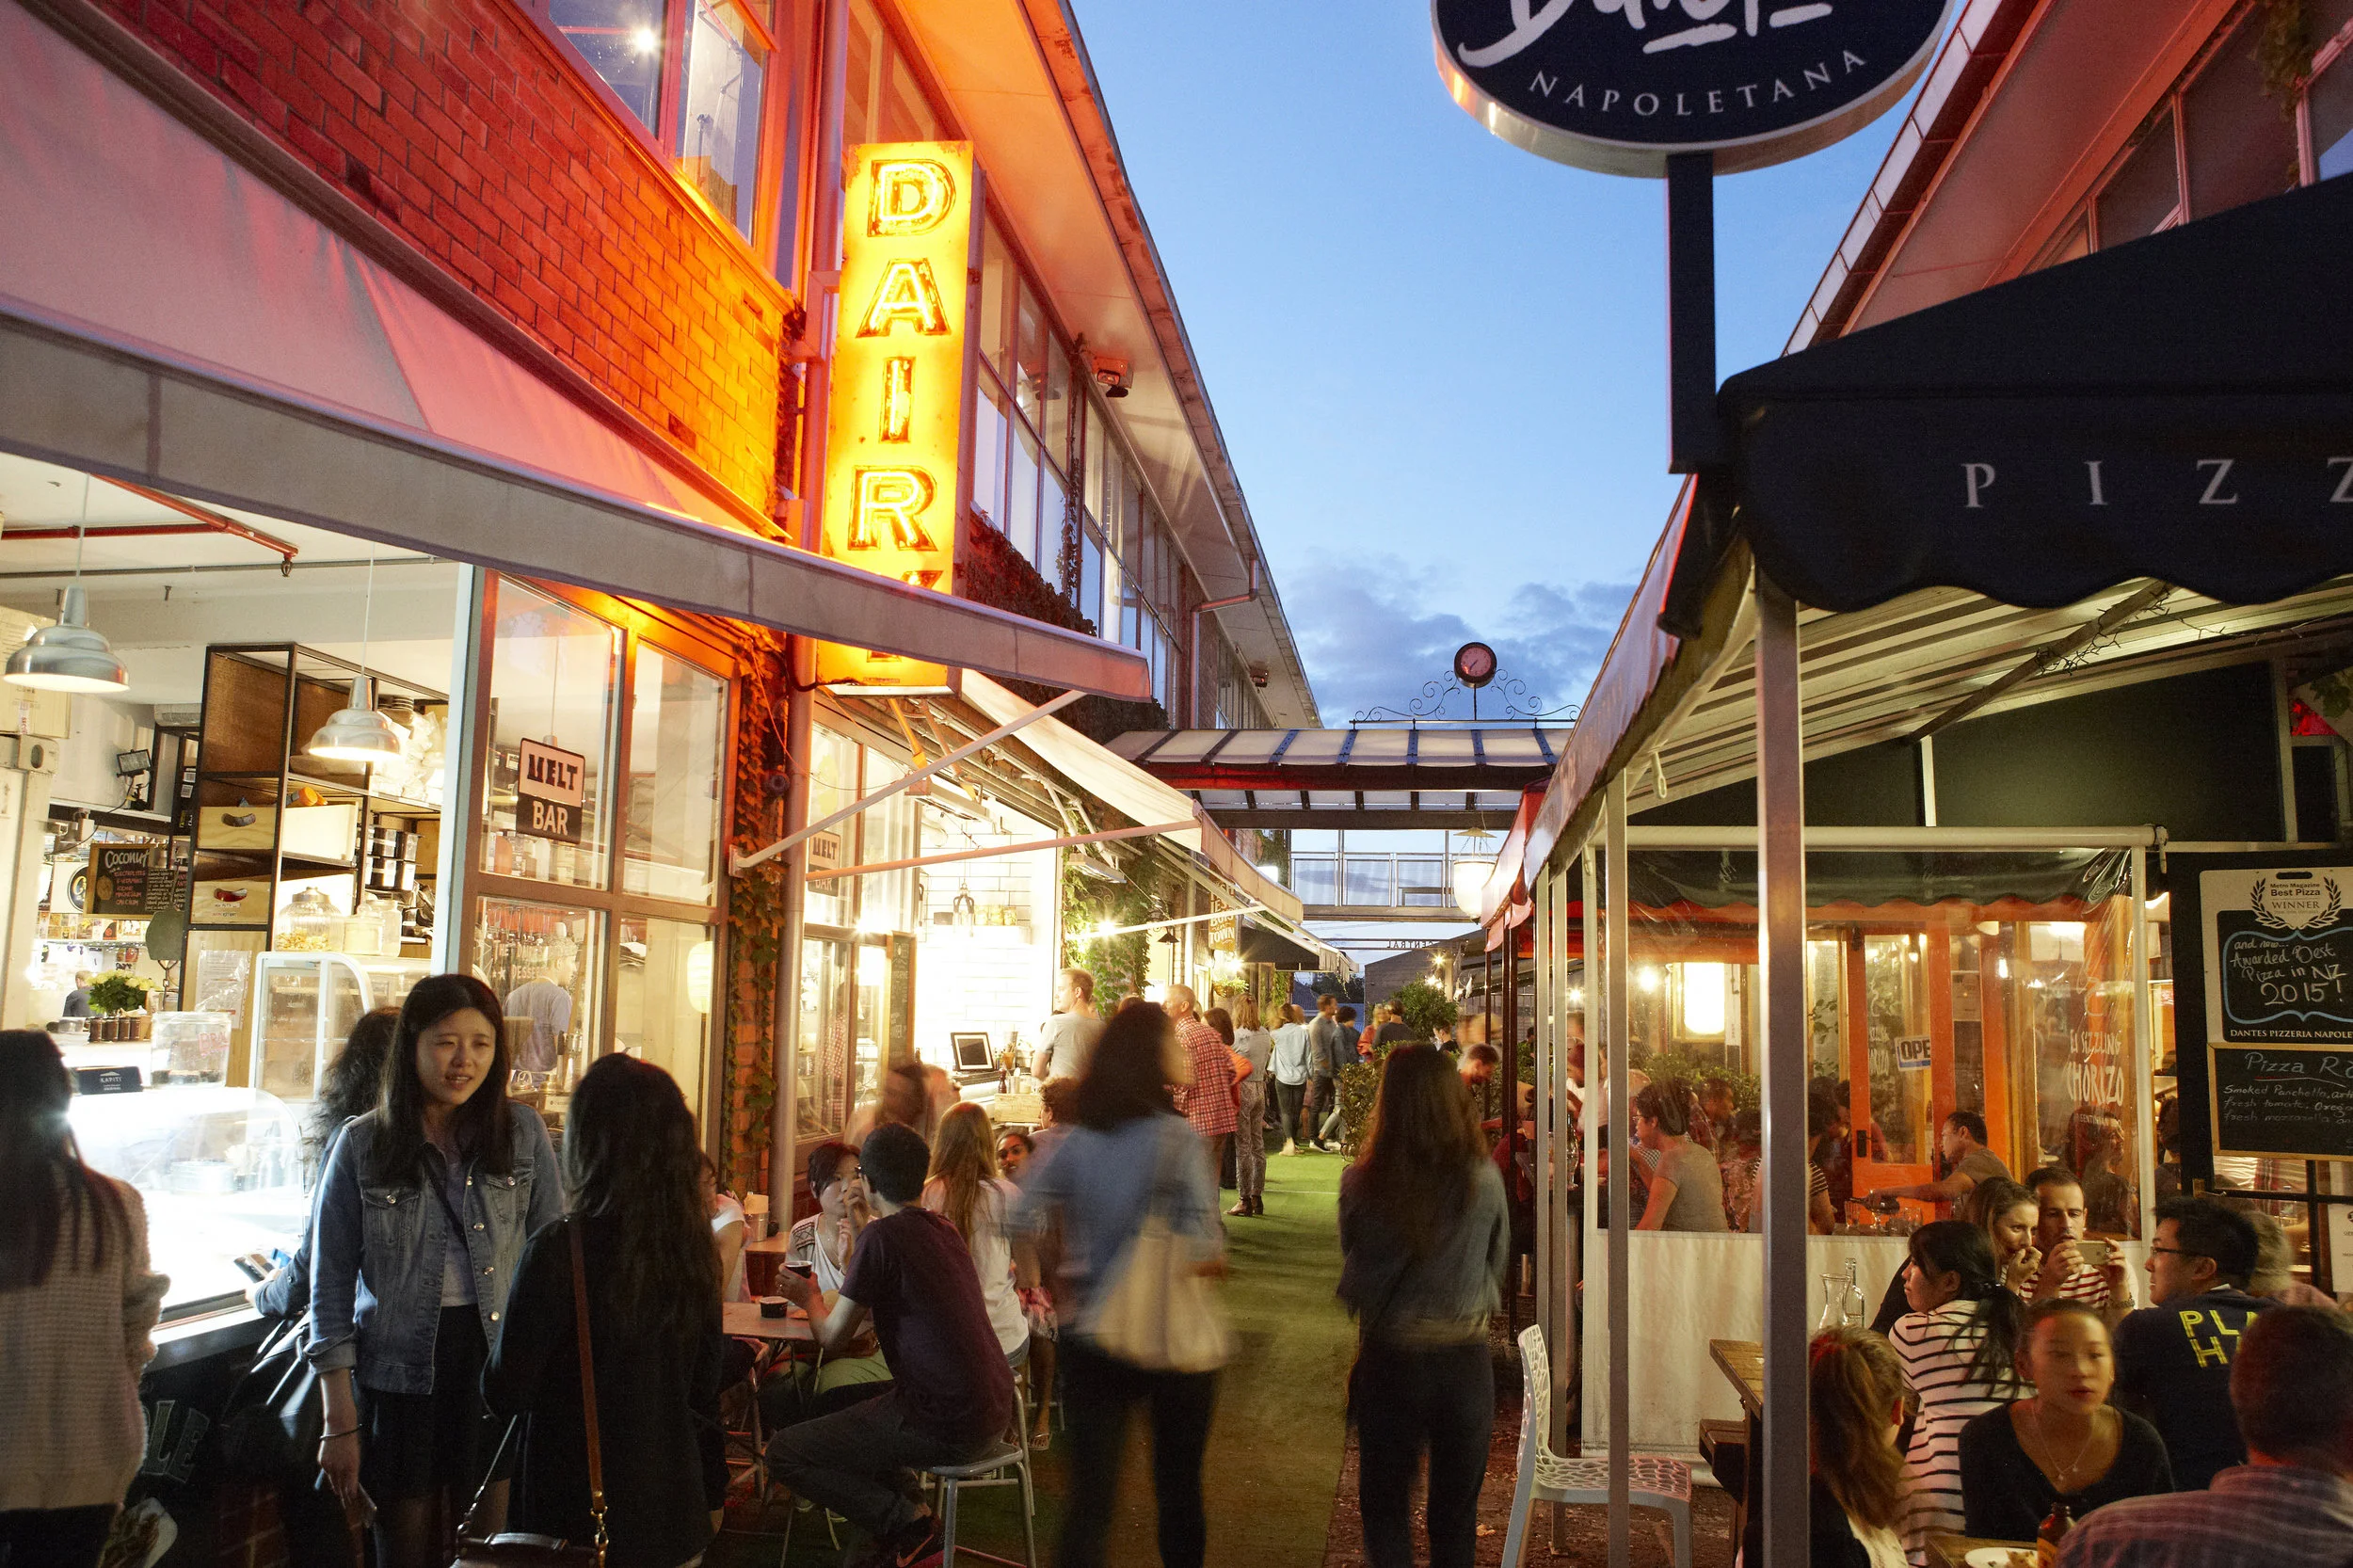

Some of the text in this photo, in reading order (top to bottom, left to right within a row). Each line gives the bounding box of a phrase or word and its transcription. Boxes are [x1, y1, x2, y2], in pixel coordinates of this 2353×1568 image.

[1529, 49, 1866, 117] NAPOLETANA
[848, 158, 957, 663] DAIR
[527, 754, 578, 791] MELT
[533, 800, 568, 836] BAR
[104, 849, 150, 869] Coconut
[2270, 888, 2321, 897] Best Pizza
[2271, 901, 2320, 909] WINNER
[1209, 926, 1235, 945] TOWN
[2234, 938, 2257, 950] and
[2230, 949, 2290, 968] Awarded
[2241, 964, 2347, 983] Pizza in NZ
[2230, 1029, 2266, 1037] DANTES
[2269, 1030, 2312, 1038] PIZZERIA
[2245, 1051, 2305, 1073] Pizza
[2067, 1061, 2124, 1107] CHORIZO
[2223, 1084, 2268, 1095] Smoked
